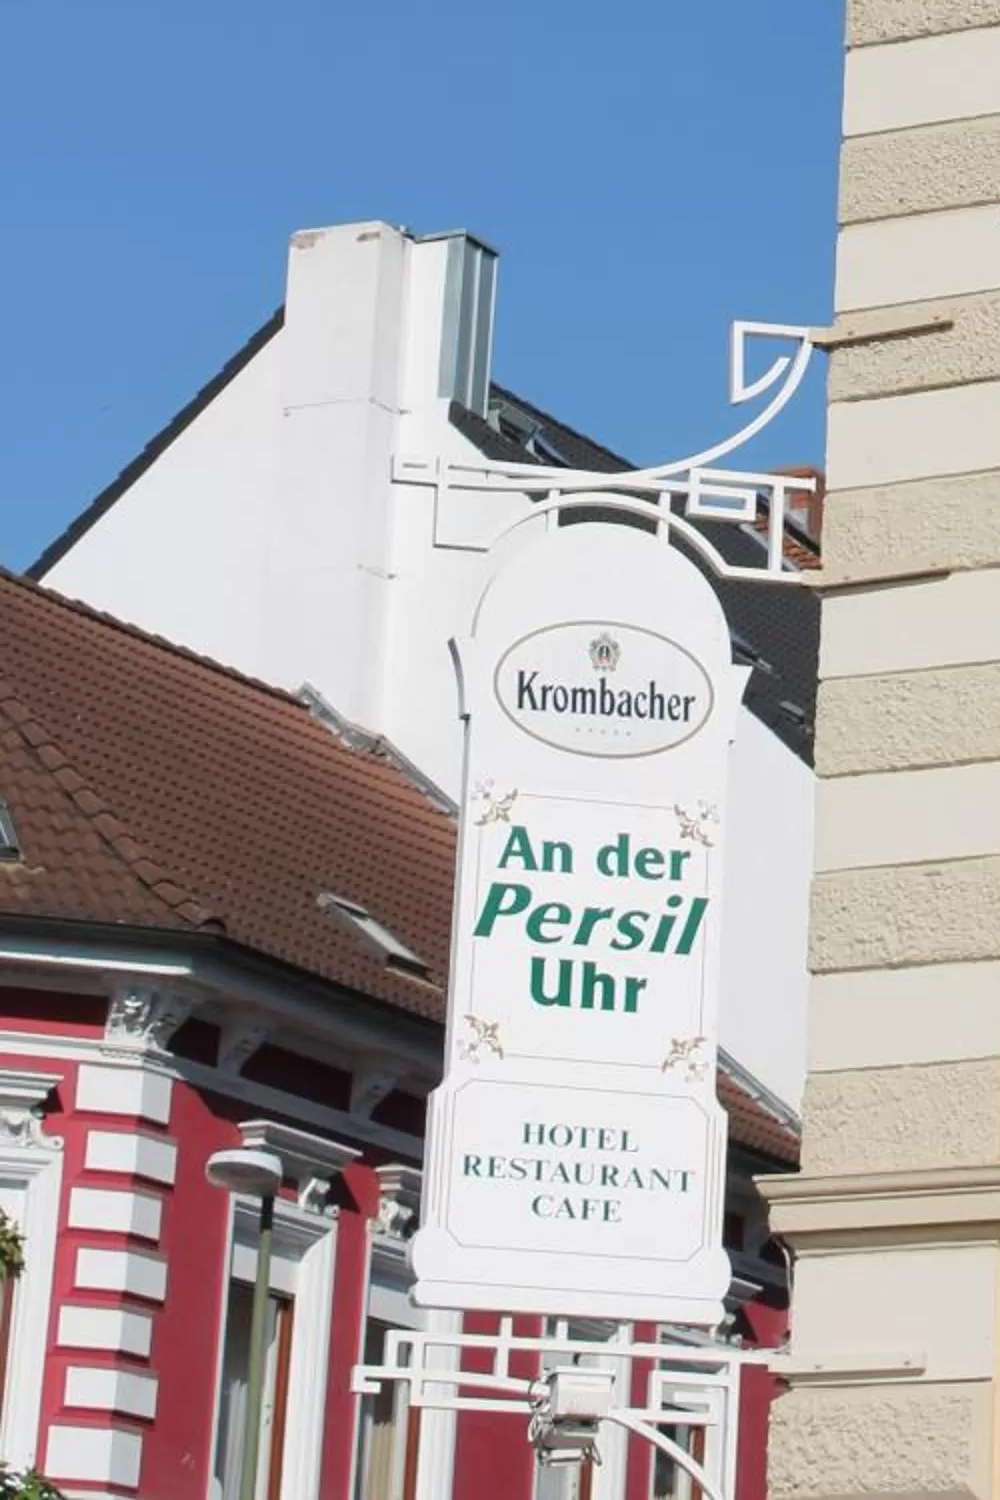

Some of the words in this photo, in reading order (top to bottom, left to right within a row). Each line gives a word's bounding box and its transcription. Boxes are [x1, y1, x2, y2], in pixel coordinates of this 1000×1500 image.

[516, 670, 697, 722] Krombacher
[498, 825, 574, 874] An
[596, 833, 691, 881] der
[473, 881, 710, 955] Persil
[530, 956, 648, 1013] Uhr
[522, 1122, 640, 1153] HOTEL
[463, 1154, 696, 1193] RESTAURANT
[531, 1195, 623, 1223] CAFE
